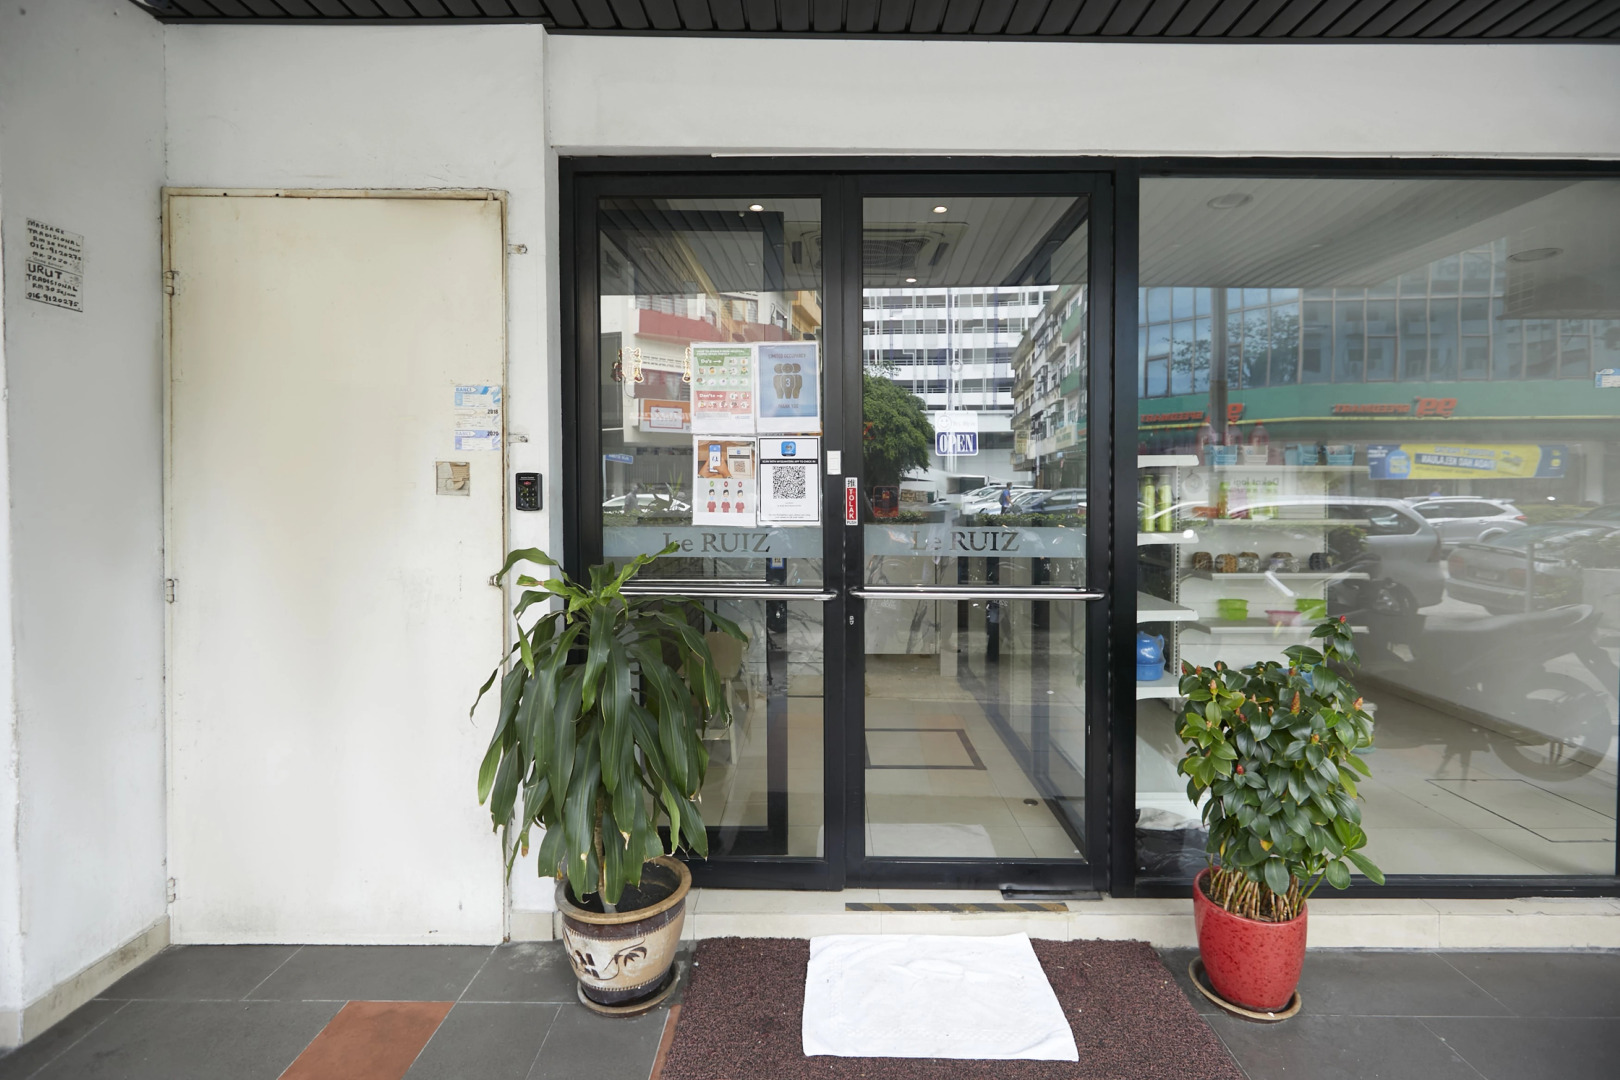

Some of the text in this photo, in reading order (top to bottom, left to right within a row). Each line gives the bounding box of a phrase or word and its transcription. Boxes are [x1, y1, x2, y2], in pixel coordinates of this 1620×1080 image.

[27, 220, 65, 235] MASSAGE
[27, 263, 63, 280] URUT
[26, 273, 78, 292] TRADISIONAL
[785, 377, 791, 388] 3
[939, 434, 974, 453] OPEN
[700, 532, 771, 553] RUIZ
[949, 531, 1020, 552] RUIZ
